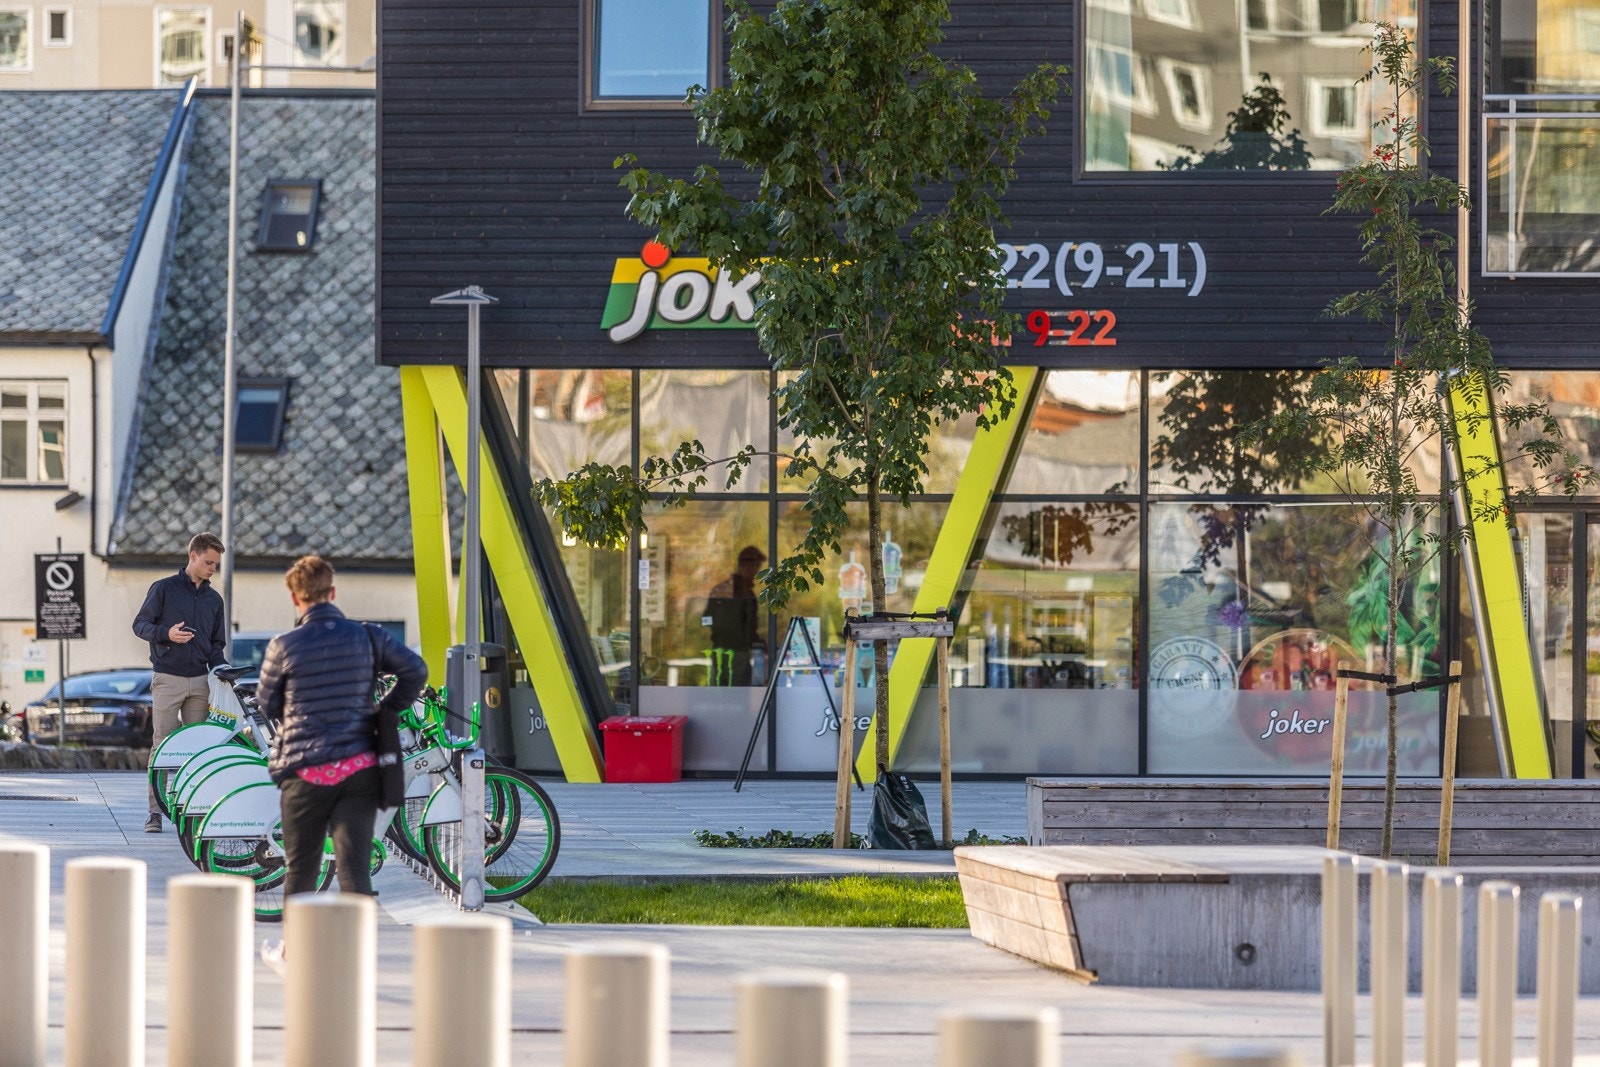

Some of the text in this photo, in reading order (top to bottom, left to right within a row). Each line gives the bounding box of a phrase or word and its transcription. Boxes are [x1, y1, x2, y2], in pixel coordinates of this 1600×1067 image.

[983, 242, 1207, 296] 22(9-21)
[608, 240, 762, 344] jok
[1027, 309, 1117, 346] 9-22
[207, 708, 235, 725] ker
[1260, 709, 1330, 739] joker
[210, 820, 266, 829] bergenbysykkel.no
